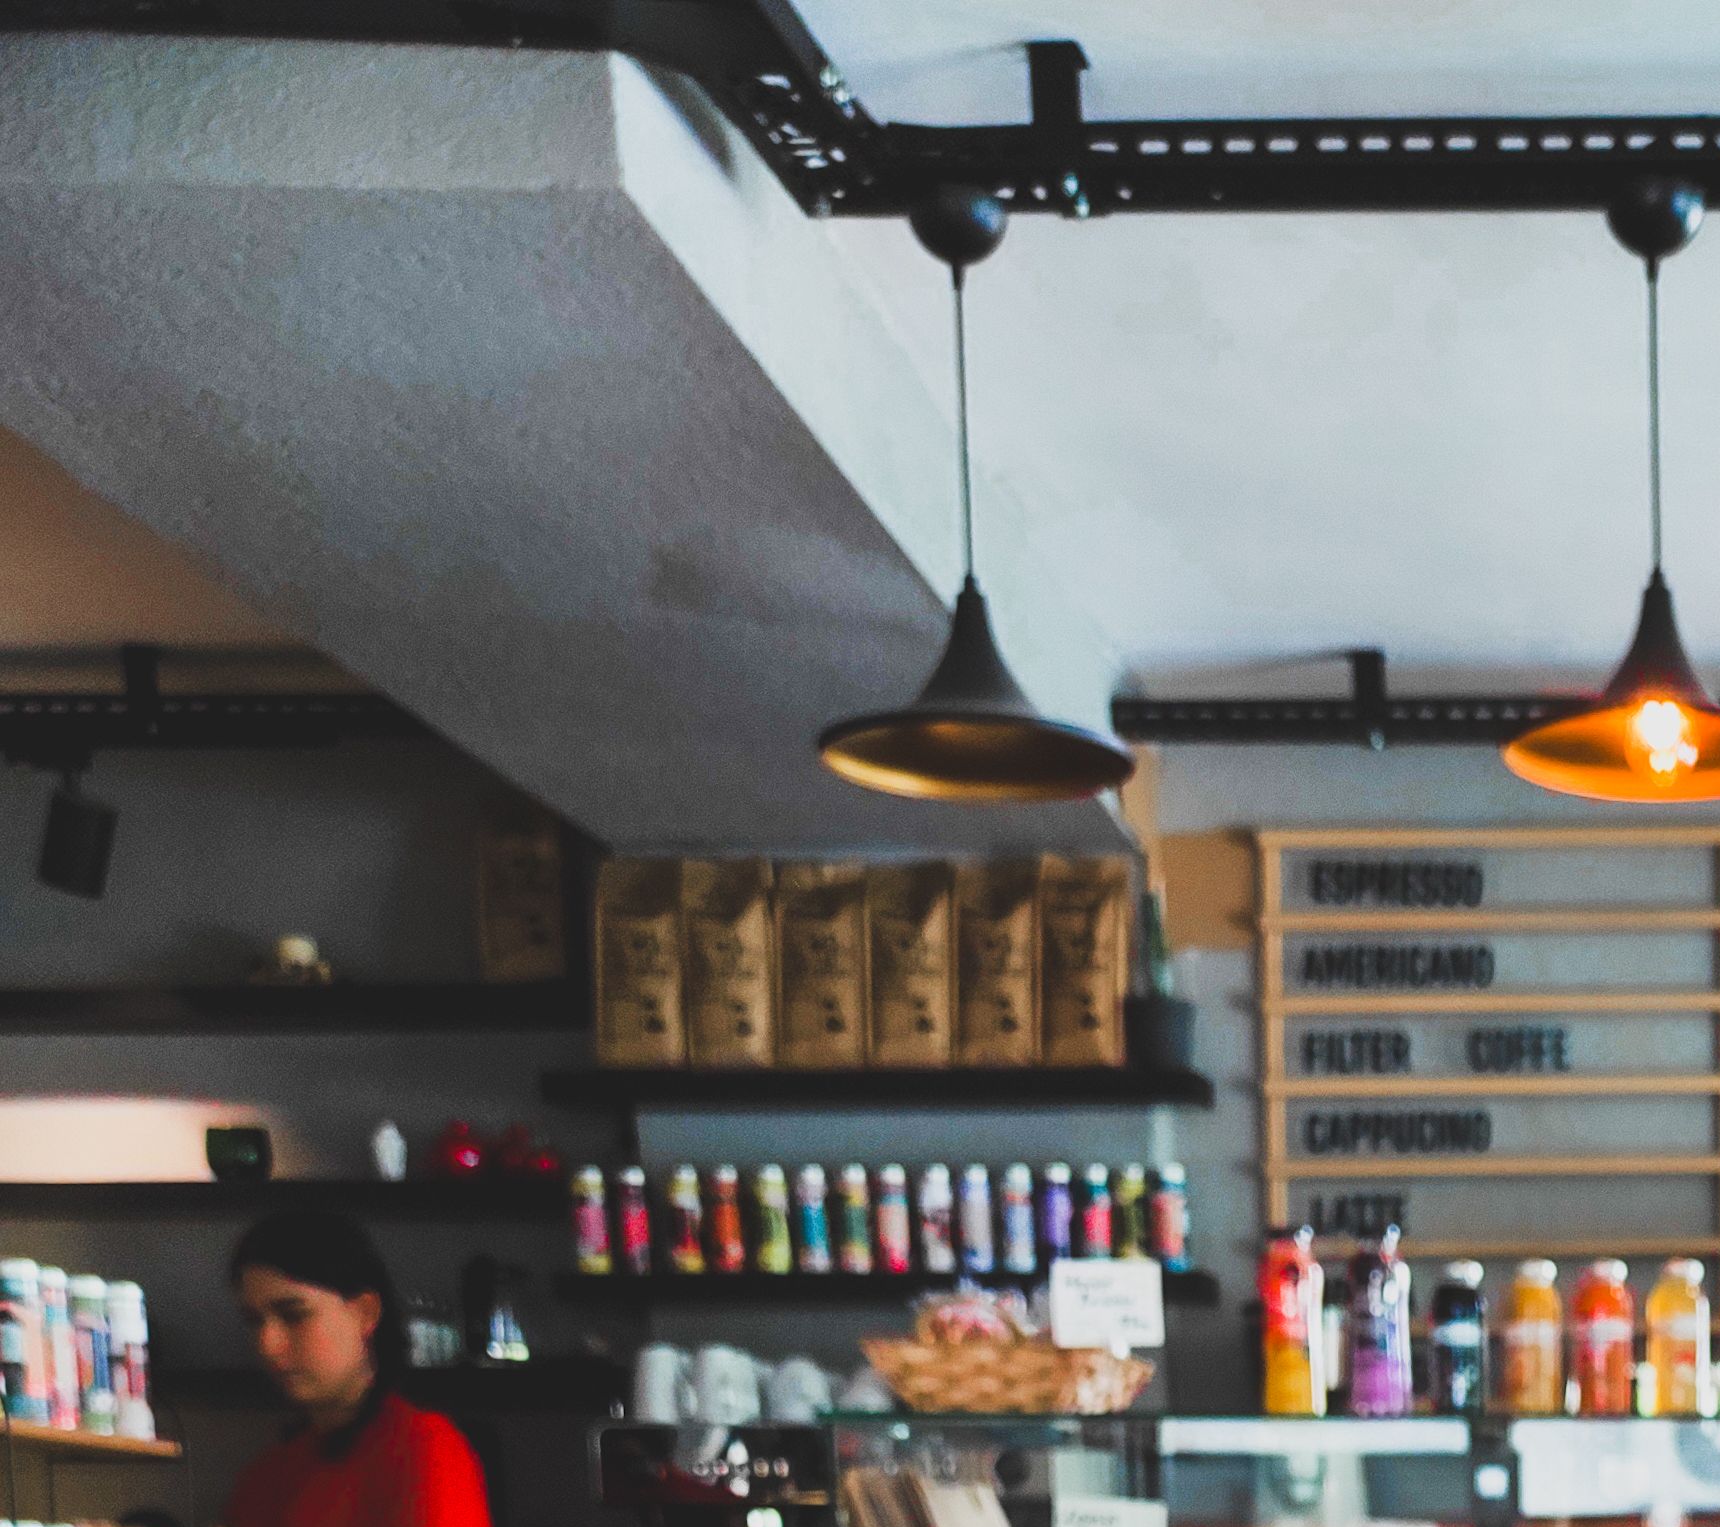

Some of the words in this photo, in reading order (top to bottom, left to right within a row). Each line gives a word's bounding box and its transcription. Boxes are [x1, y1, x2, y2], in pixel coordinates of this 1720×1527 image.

[1309, 861, 1483, 907] ESPRESSO
[1303, 946, 1494, 989] AMERICANO
[1303, 1030, 1411, 1075] FILTER
[1467, 1026, 1569, 1074] COFFE
[1305, 1110, 1491, 1153] CAPPUCINO
